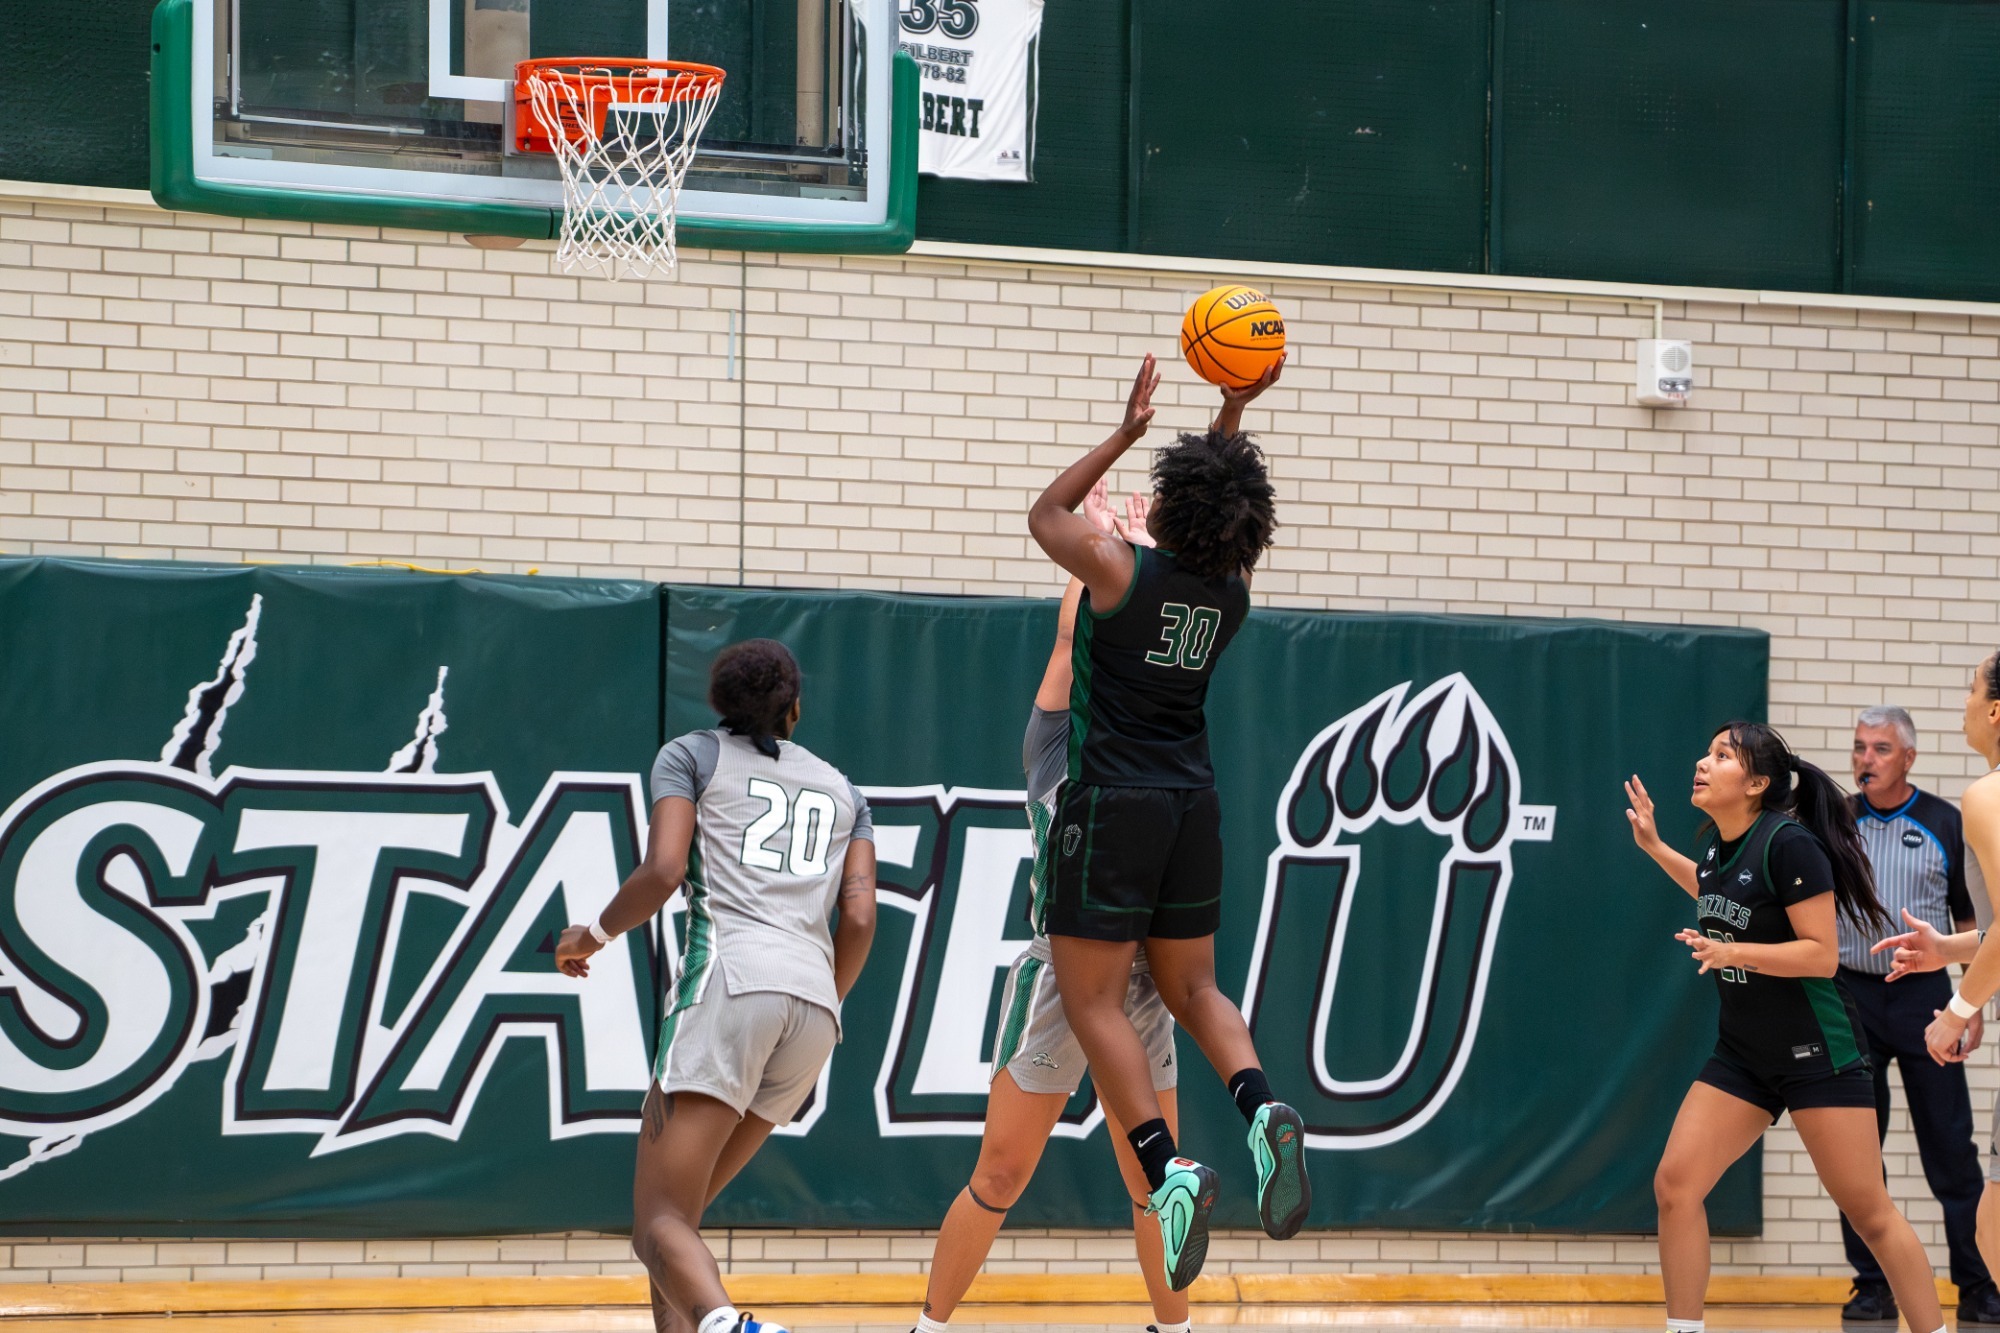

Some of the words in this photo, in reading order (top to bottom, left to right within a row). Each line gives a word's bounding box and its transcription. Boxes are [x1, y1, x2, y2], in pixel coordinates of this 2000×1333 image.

[899, 0, 979, 39] 35
[919, 92, 983, 138] BERT
[1251, 320, 1285, 336] NCAA
[1145, 602, 1221, 670] 30
[740, 777, 838, 876] 20
[1697, 893, 1752, 931] RIZZLIES
[0, 758, 1108, 1158] STAE
[1523, 815, 1547, 831] TM
